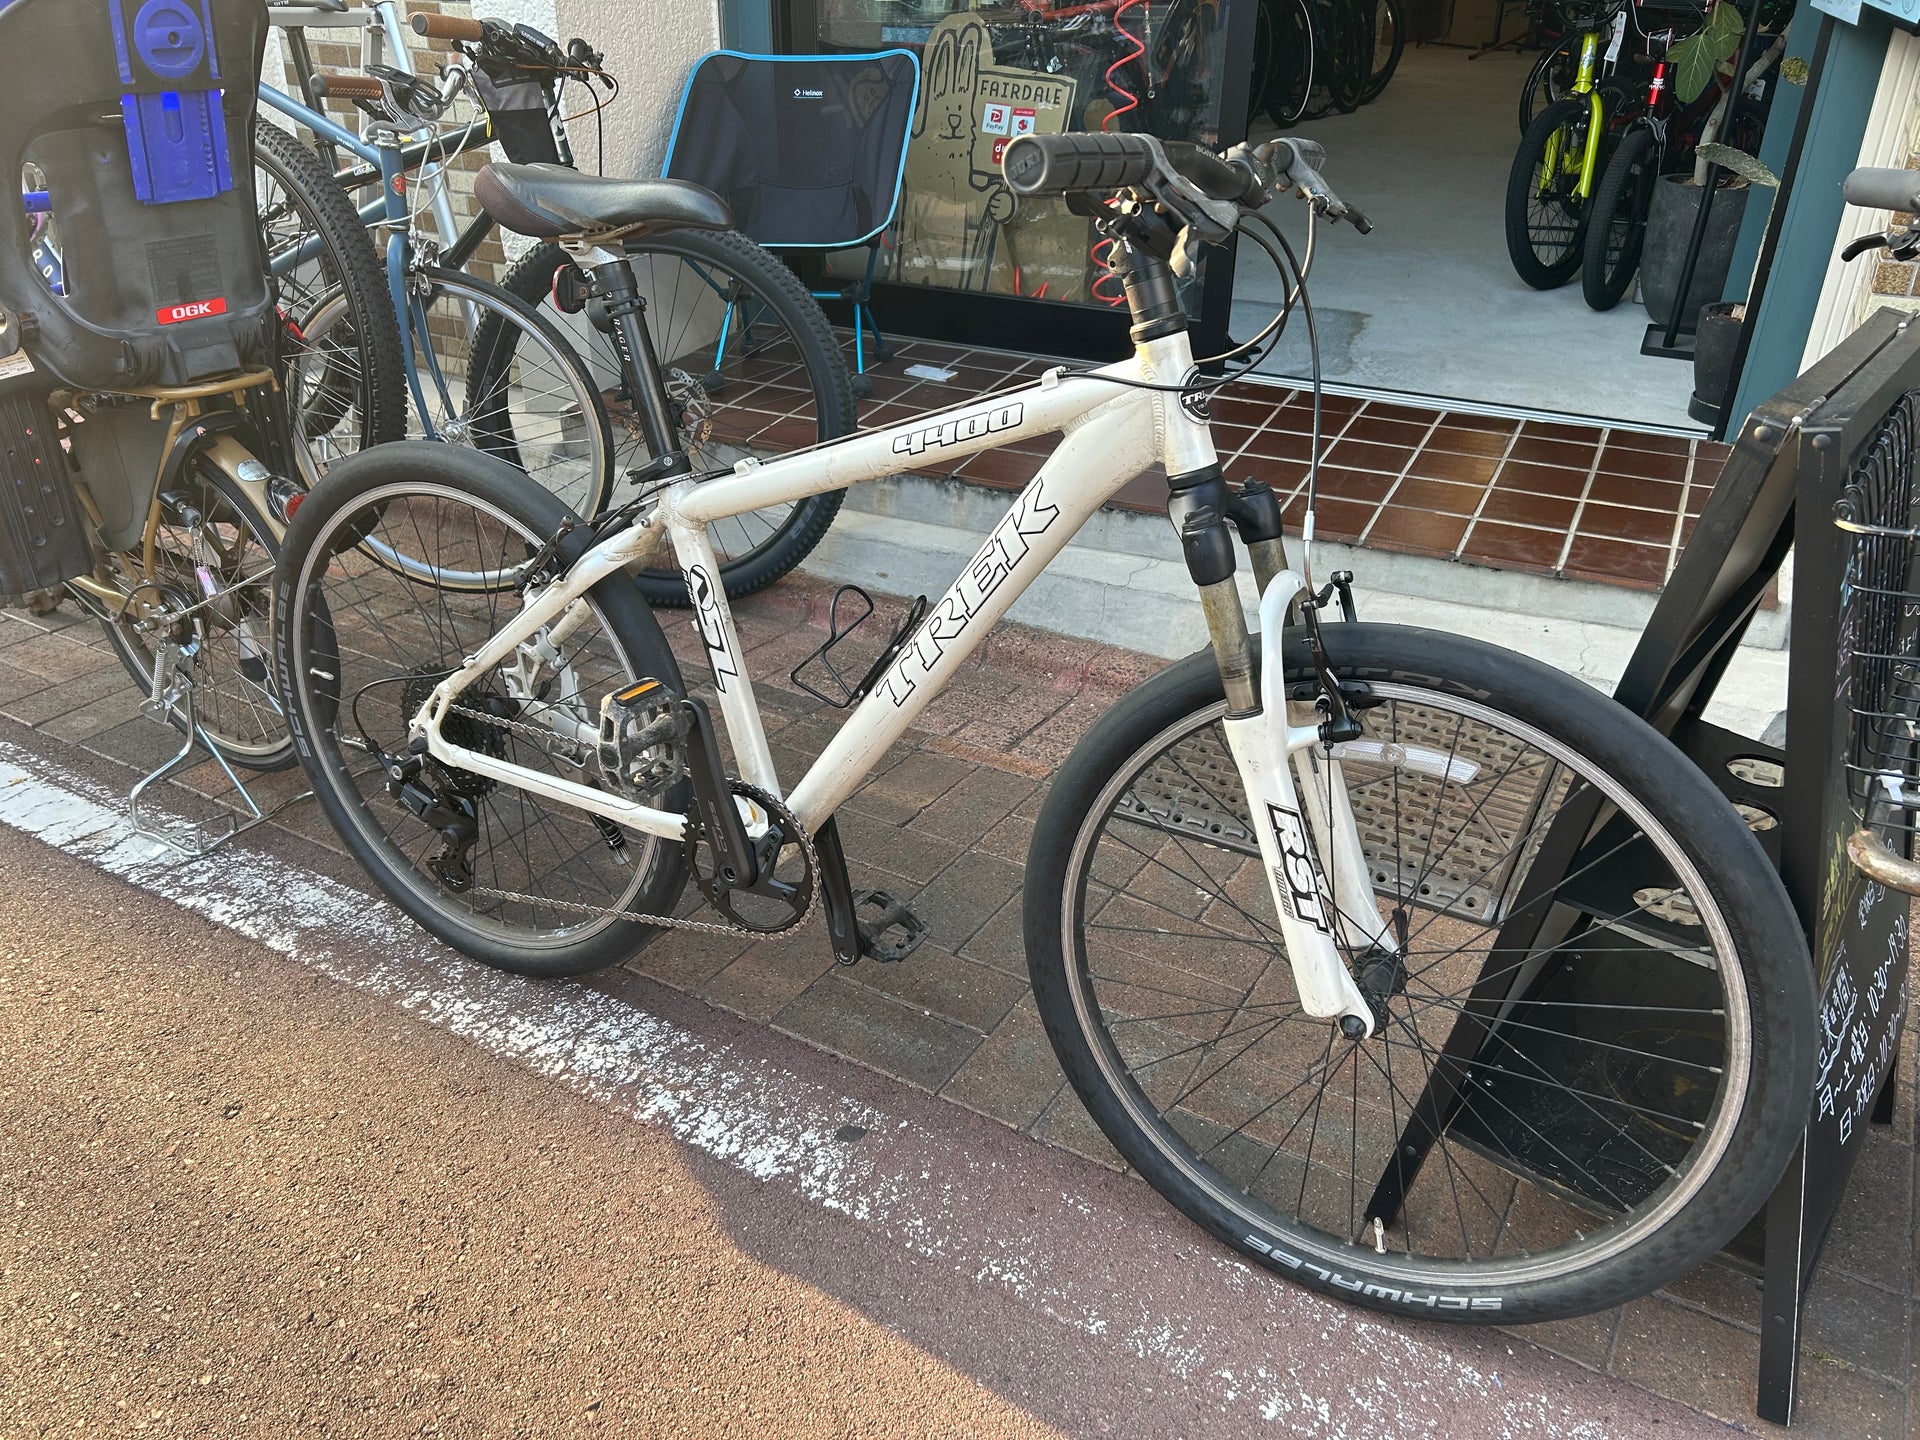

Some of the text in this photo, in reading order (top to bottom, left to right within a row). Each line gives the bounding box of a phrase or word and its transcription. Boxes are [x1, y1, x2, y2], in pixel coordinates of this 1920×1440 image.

[980, 79, 1063, 105] FAIRDALE
[985, 122, 1004, 131] PayPay
[171, 302, 212, 320] OGK
[892, 402, 1024, 456] 4400
[875, 476, 1060, 708] TREK
[276, 580, 312, 758] SCHWALBE
[1266, 802, 1330, 934] RST
[1243, 1234, 1503, 1310] SCHWALBE
